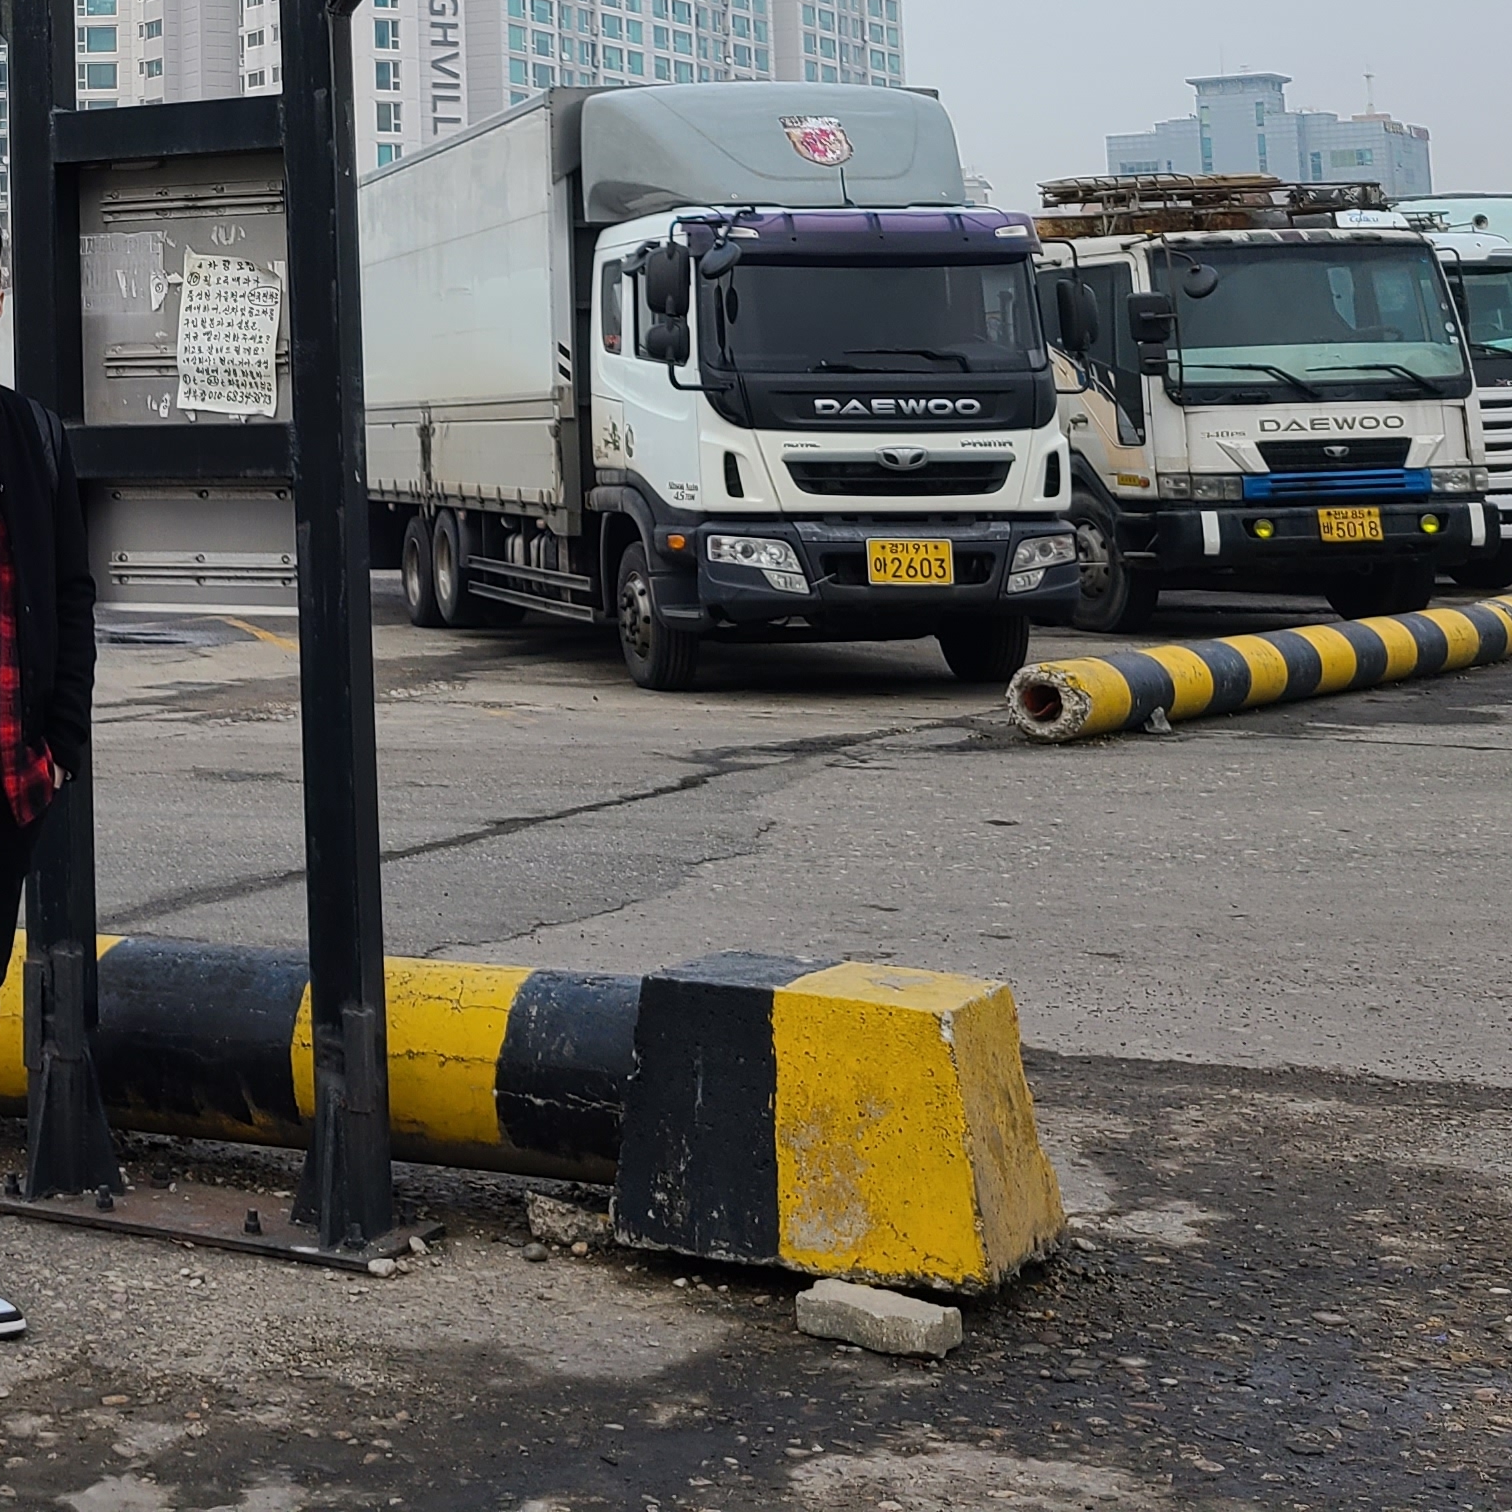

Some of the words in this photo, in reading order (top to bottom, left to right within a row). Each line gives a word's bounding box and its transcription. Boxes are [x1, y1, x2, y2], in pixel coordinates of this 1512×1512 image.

[814, 398, 981, 415] DAEWOO
[1259, 415, 1404, 432] DAEWOO
[1322, 520, 1380, 539] 바5018
[888, 543, 909, 555] 경기
[912, 543, 930, 555] 91
[874, 557, 948, 579] 아2603
